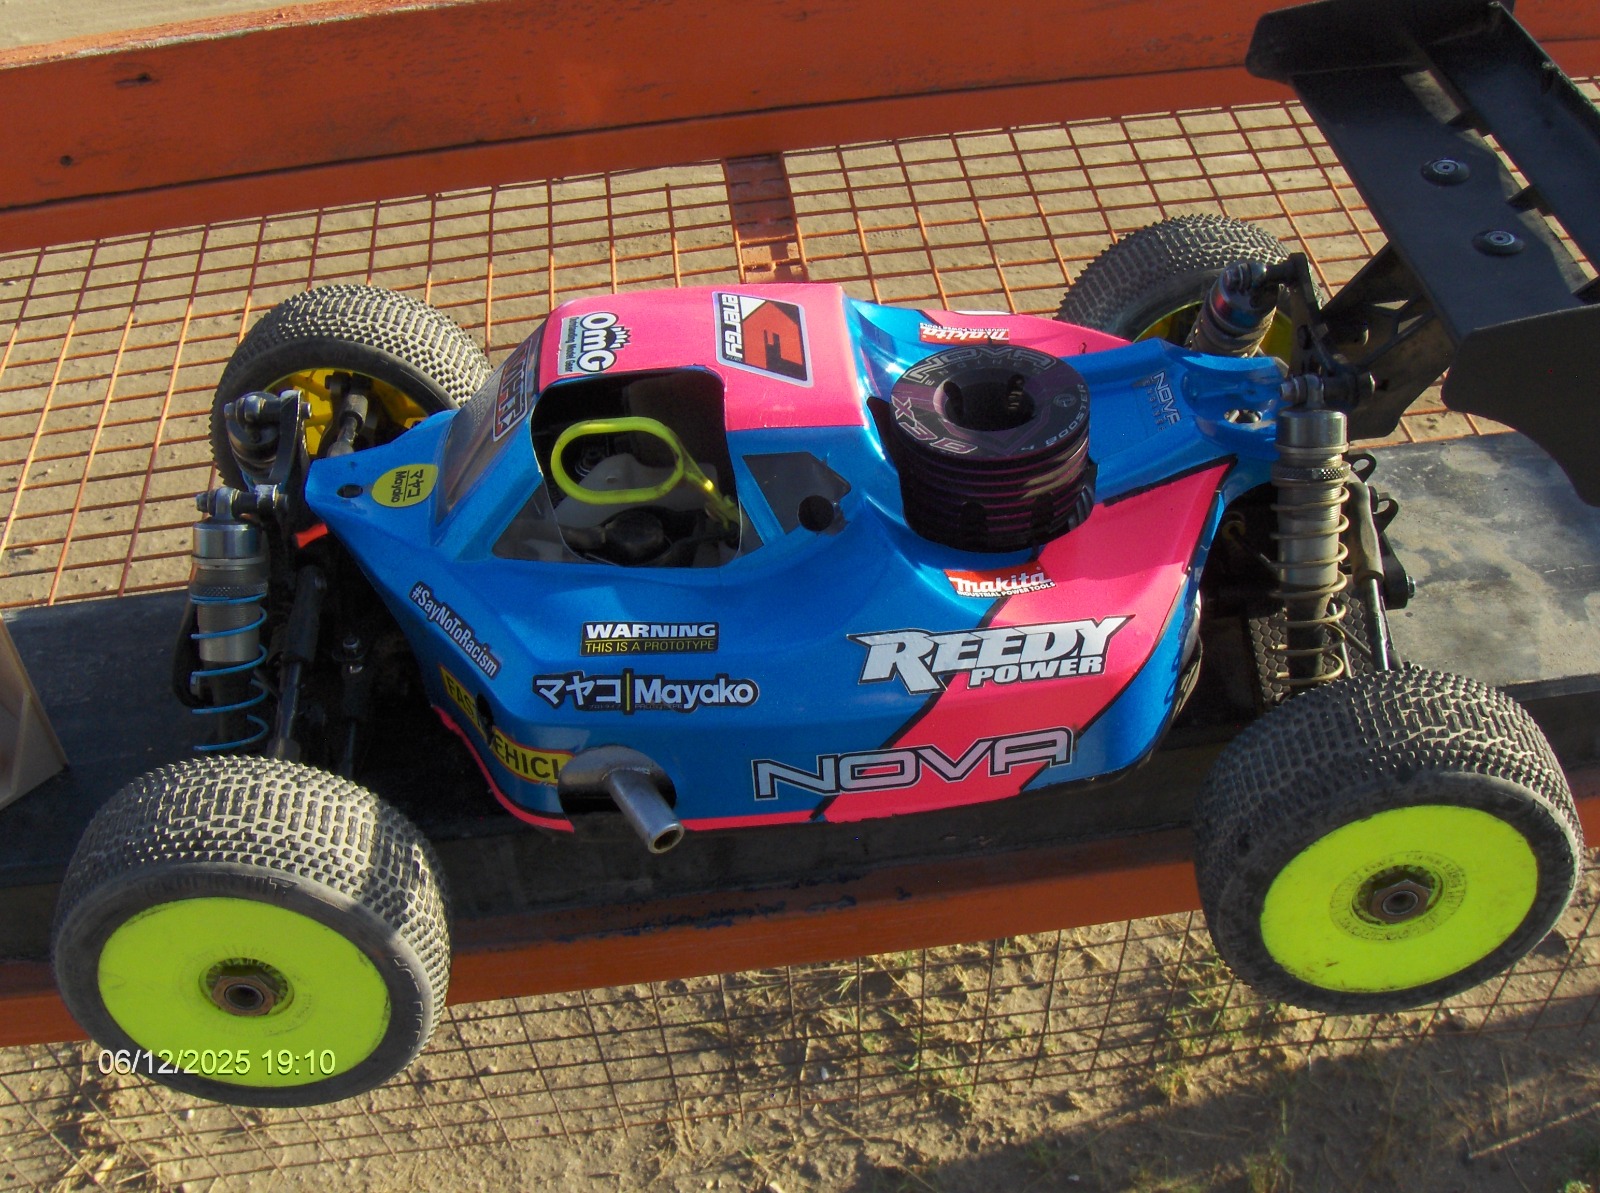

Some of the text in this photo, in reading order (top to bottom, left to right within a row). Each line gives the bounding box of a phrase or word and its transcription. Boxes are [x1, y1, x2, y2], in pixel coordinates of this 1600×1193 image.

[920, 329, 1009, 340] makita
[903, 345, 1058, 384] NOVA
[391, 471, 407, 503] Mayako
[407, 469, 424, 498] マヤコ
[948, 572, 1051, 593] makita
[1002, 588, 1029, 596] POWER
[1029, 581, 1056, 591] TOOLS
[411, 584, 498, 677] #SayNoToRacism
[586, 624, 716, 639] WARNING
[585, 640, 715, 653] THIS IS A PROTOTYPE
[850, 616, 1134, 693] REEDY
[969, 656, 1103, 688] POWER
[536, 675, 622, 705] マヤコ
[635, 677, 754, 708] Mayako
[753, 727, 1073, 800] NOVA
